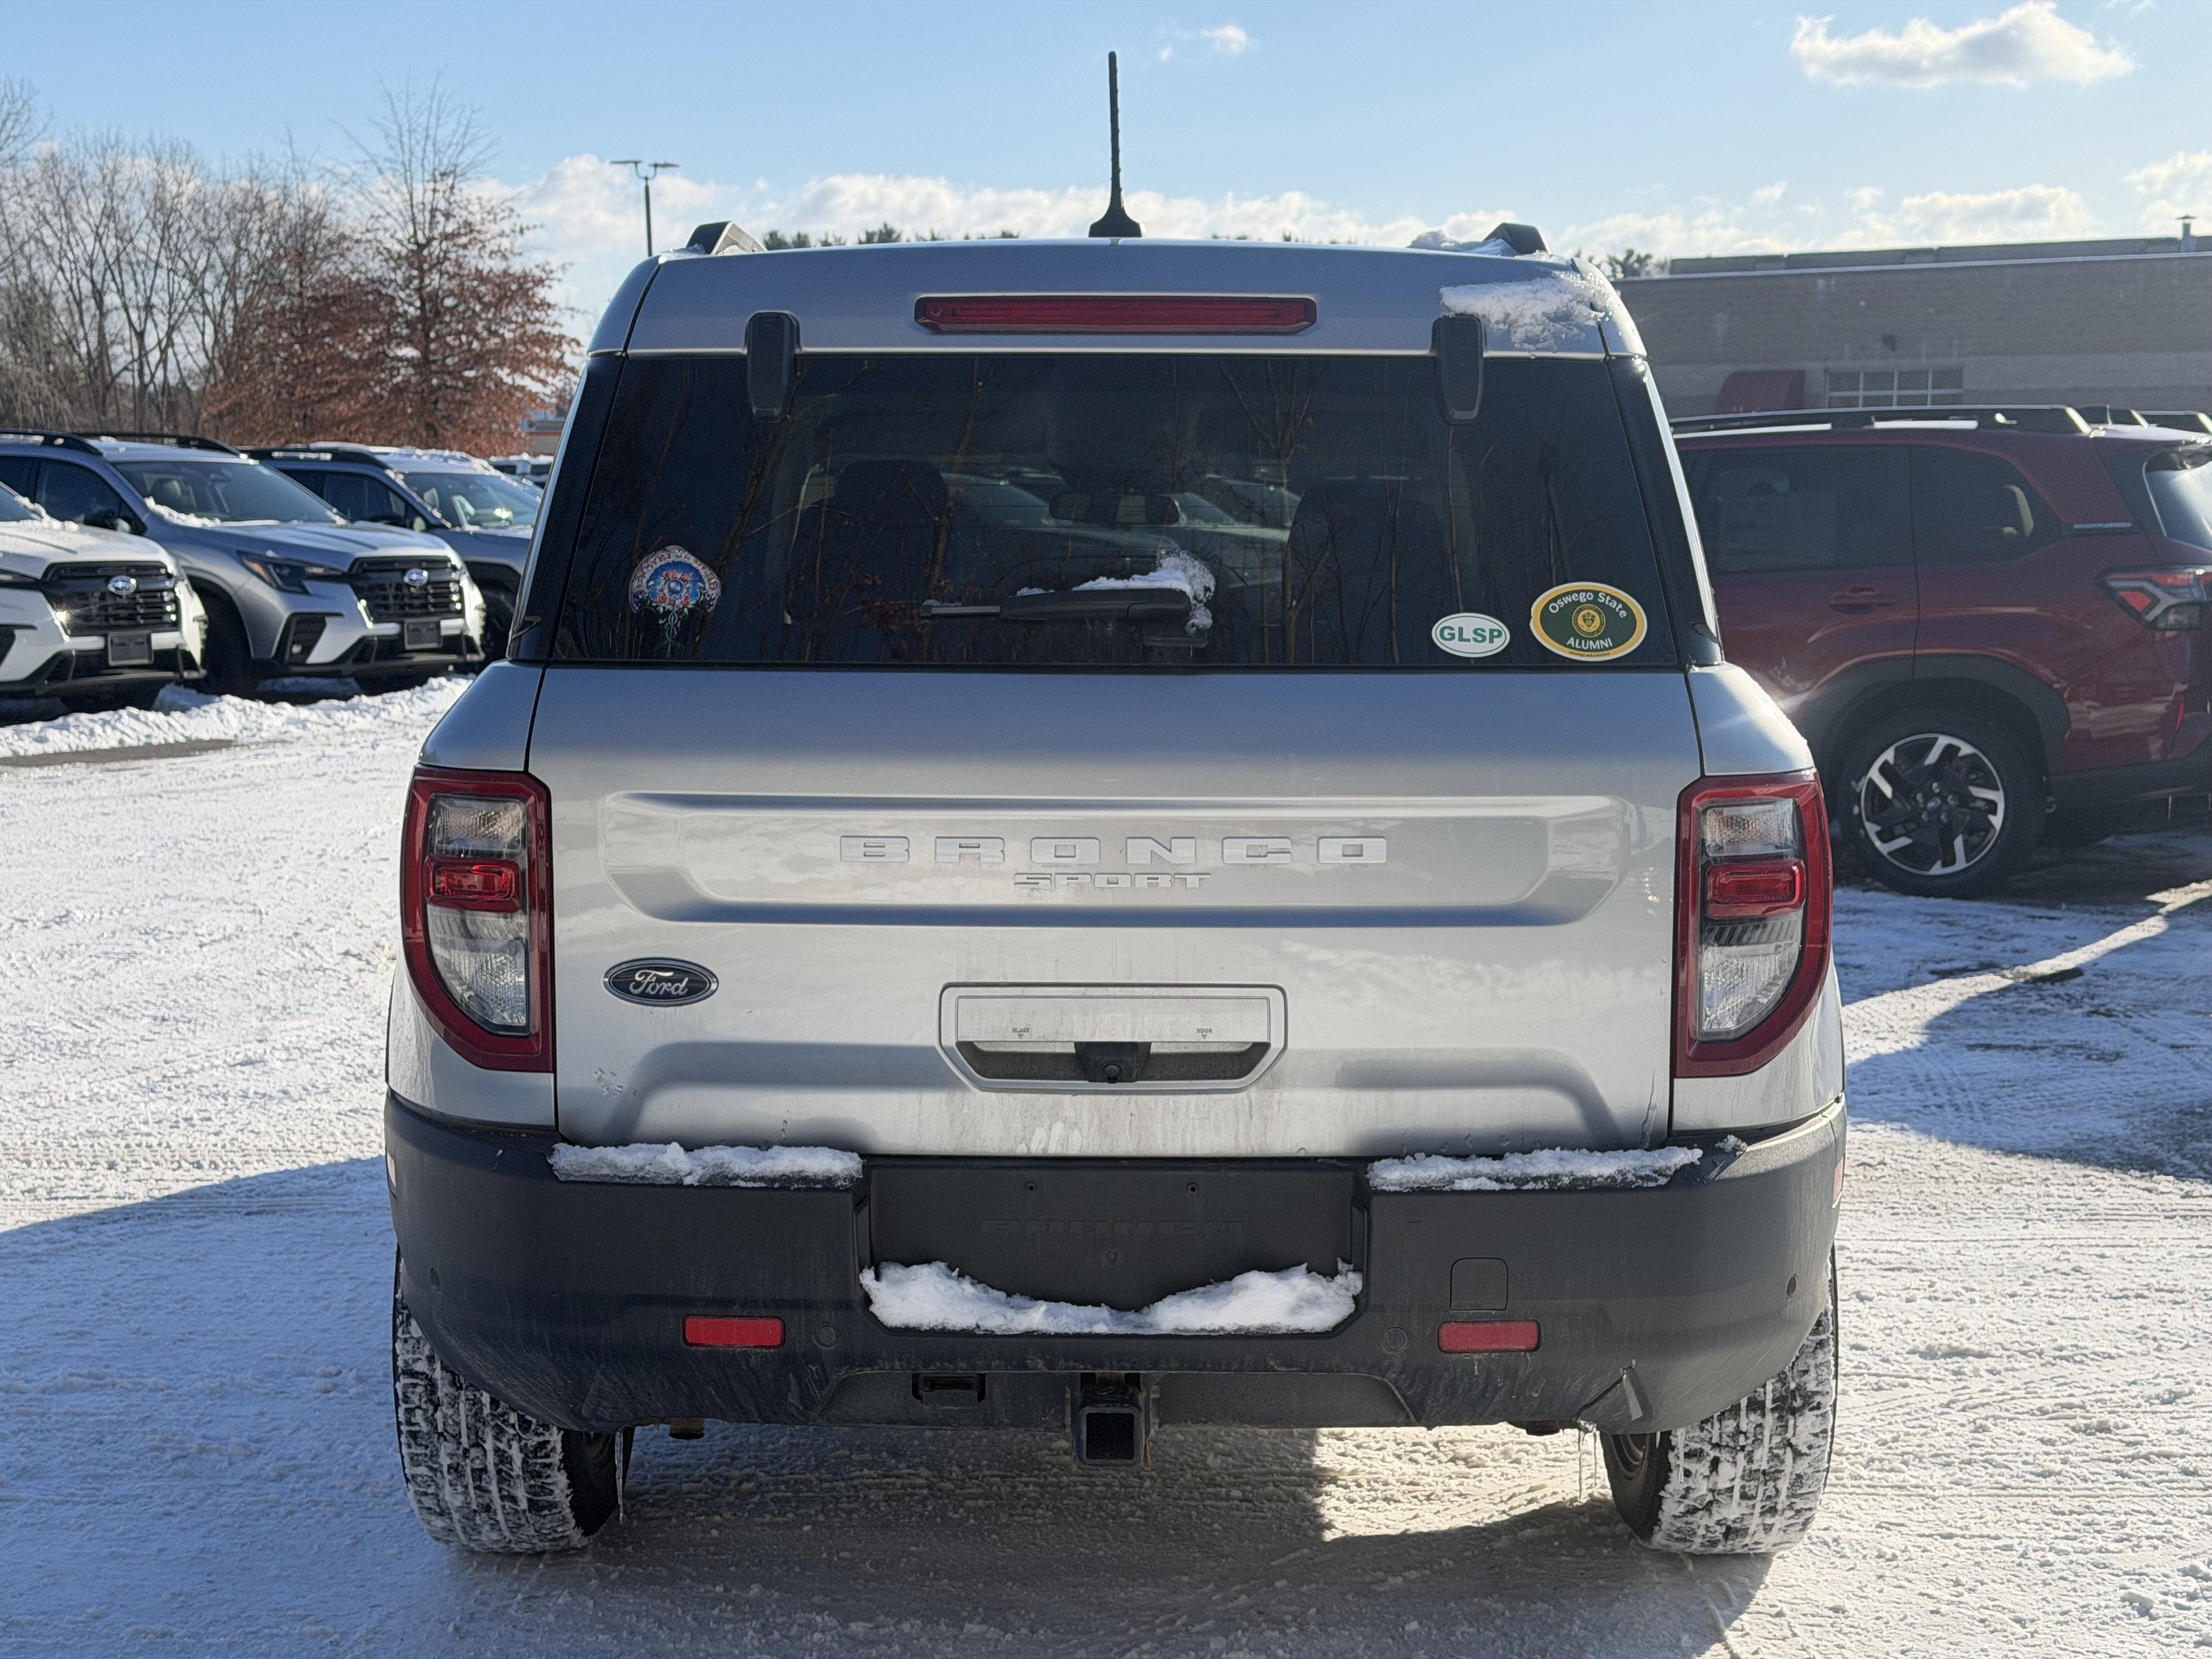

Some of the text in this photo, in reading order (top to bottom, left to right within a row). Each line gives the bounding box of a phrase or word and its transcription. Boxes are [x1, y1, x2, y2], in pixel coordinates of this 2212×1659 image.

[1549, 591, 1627, 618] Oswego State
[1439, 626, 1503, 644] GLSP
[1566, 637, 1613, 650] ALUMNI
[840, 836, 1387, 865] BRONCO
[1014, 873, 1211, 888] SPORT
[629, 969, 689, 995] Ford
